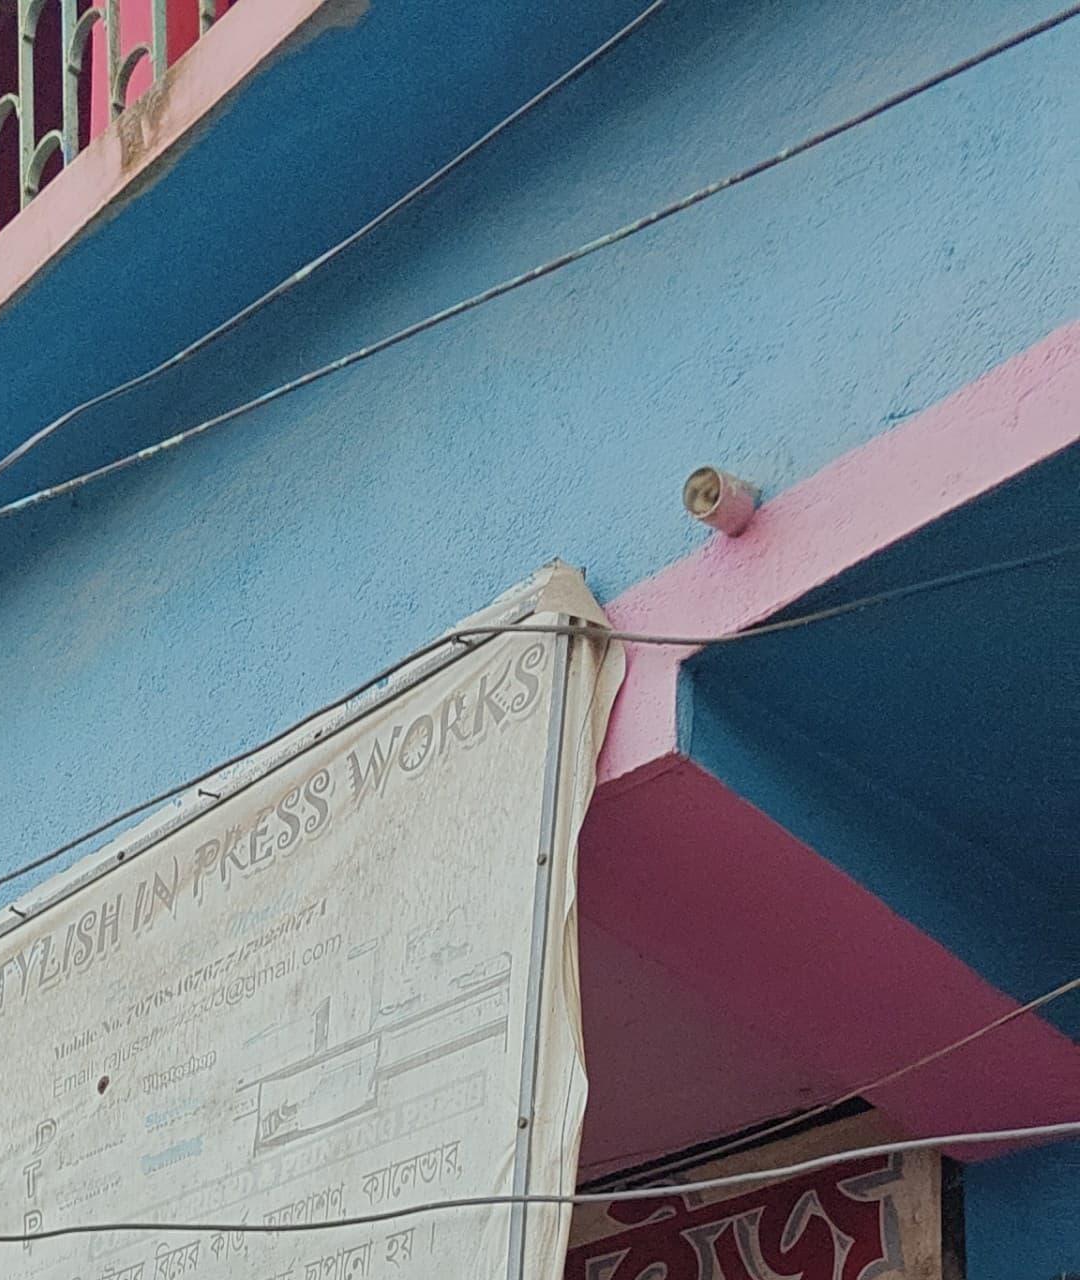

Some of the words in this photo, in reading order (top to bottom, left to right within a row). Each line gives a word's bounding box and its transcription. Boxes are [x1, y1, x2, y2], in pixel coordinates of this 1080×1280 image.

[132, 855, 182, 938] IN
[191, 767, 332, 898] PRESS
[344, 640, 547, 803] WORKS
